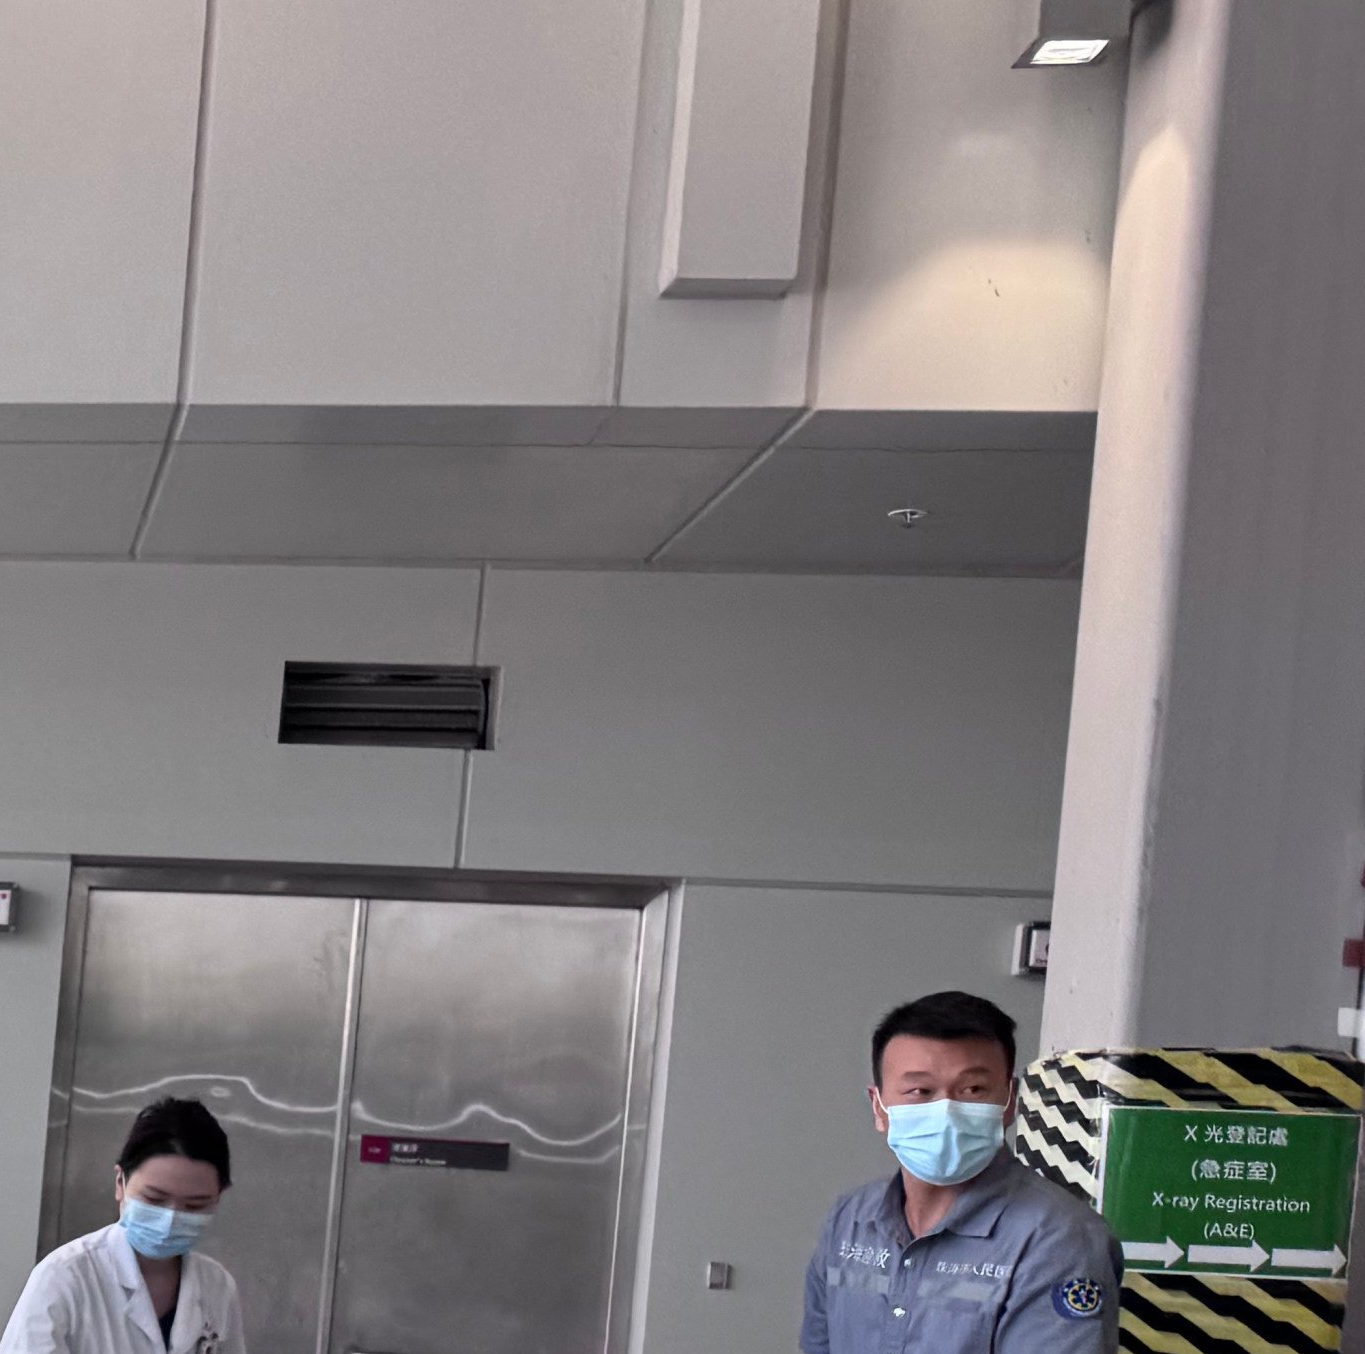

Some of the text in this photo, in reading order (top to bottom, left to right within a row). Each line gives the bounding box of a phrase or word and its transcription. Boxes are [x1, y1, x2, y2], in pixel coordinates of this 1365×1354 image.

[1191, 1159, 1277, 1183] (急症室)
[1152, 1192, 1311, 1213] X-ray Registration
[1203, 1222, 1256, 1240] (A&E)
